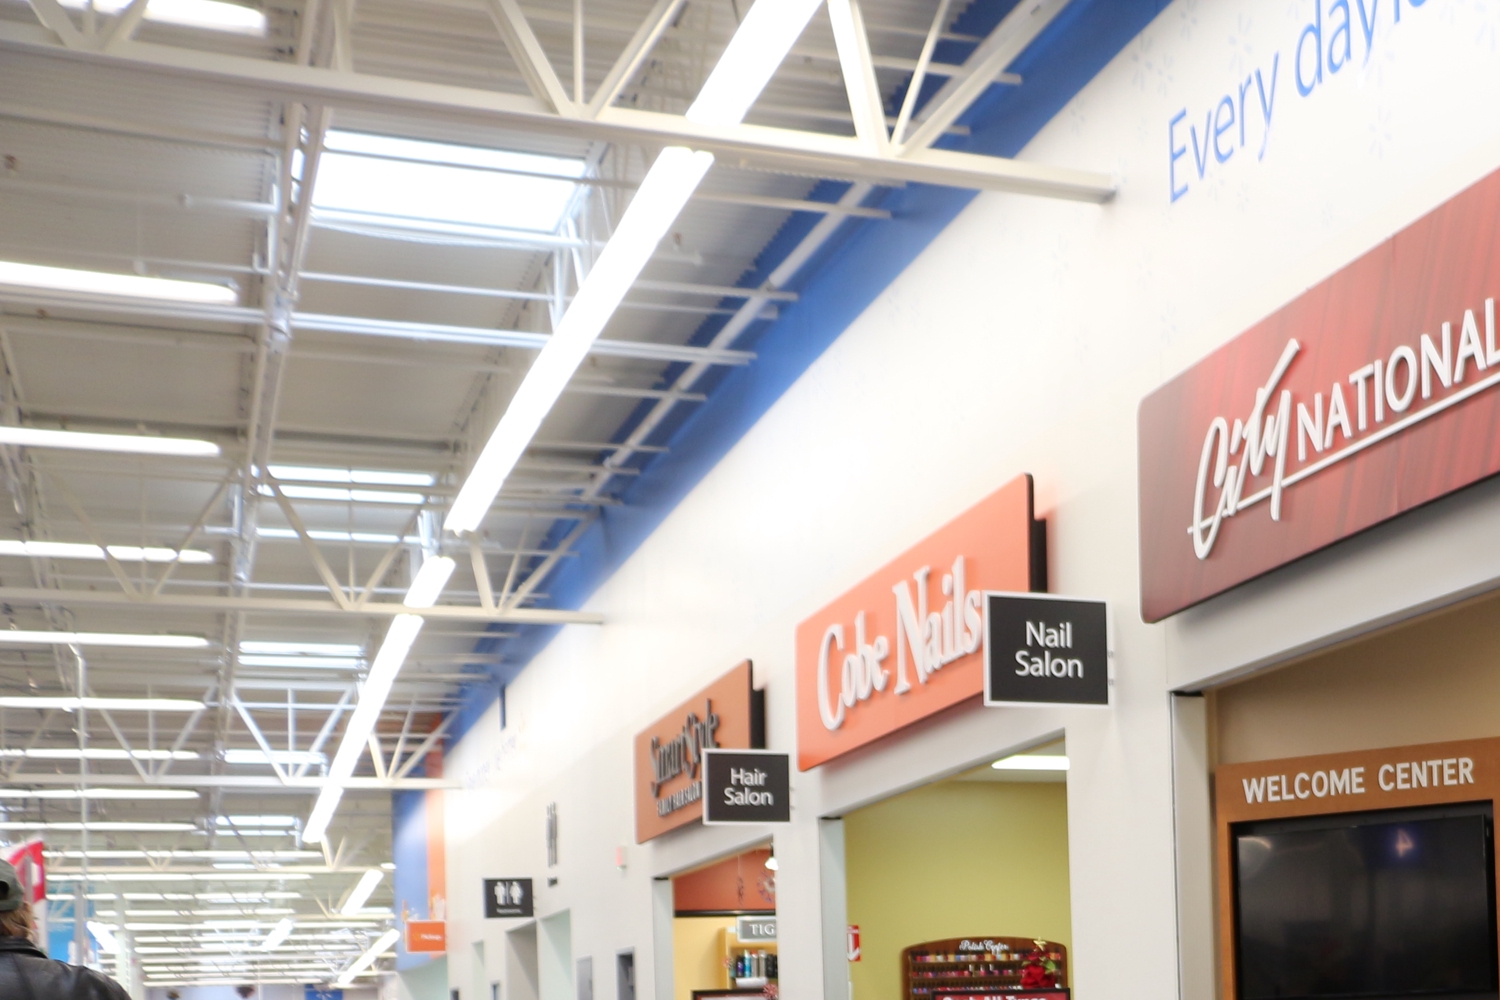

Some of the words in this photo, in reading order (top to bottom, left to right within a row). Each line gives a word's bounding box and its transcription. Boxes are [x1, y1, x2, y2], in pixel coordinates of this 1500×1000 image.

[1168, 50, 1279, 205] Every
[1192, 338, 1300, 561] City
[817, 610, 890, 732] Cobe
[891, 554, 982, 695] Nails
[1025, 620, 1073, 649] Nail
[1014, 650, 1084, 679] Salon
[723, 786, 775, 806] Salon
[730, 767, 768, 787] Hair
[1241, 766, 1366, 804] WELCOME
[1377, 757, 1475, 792] CENTER
